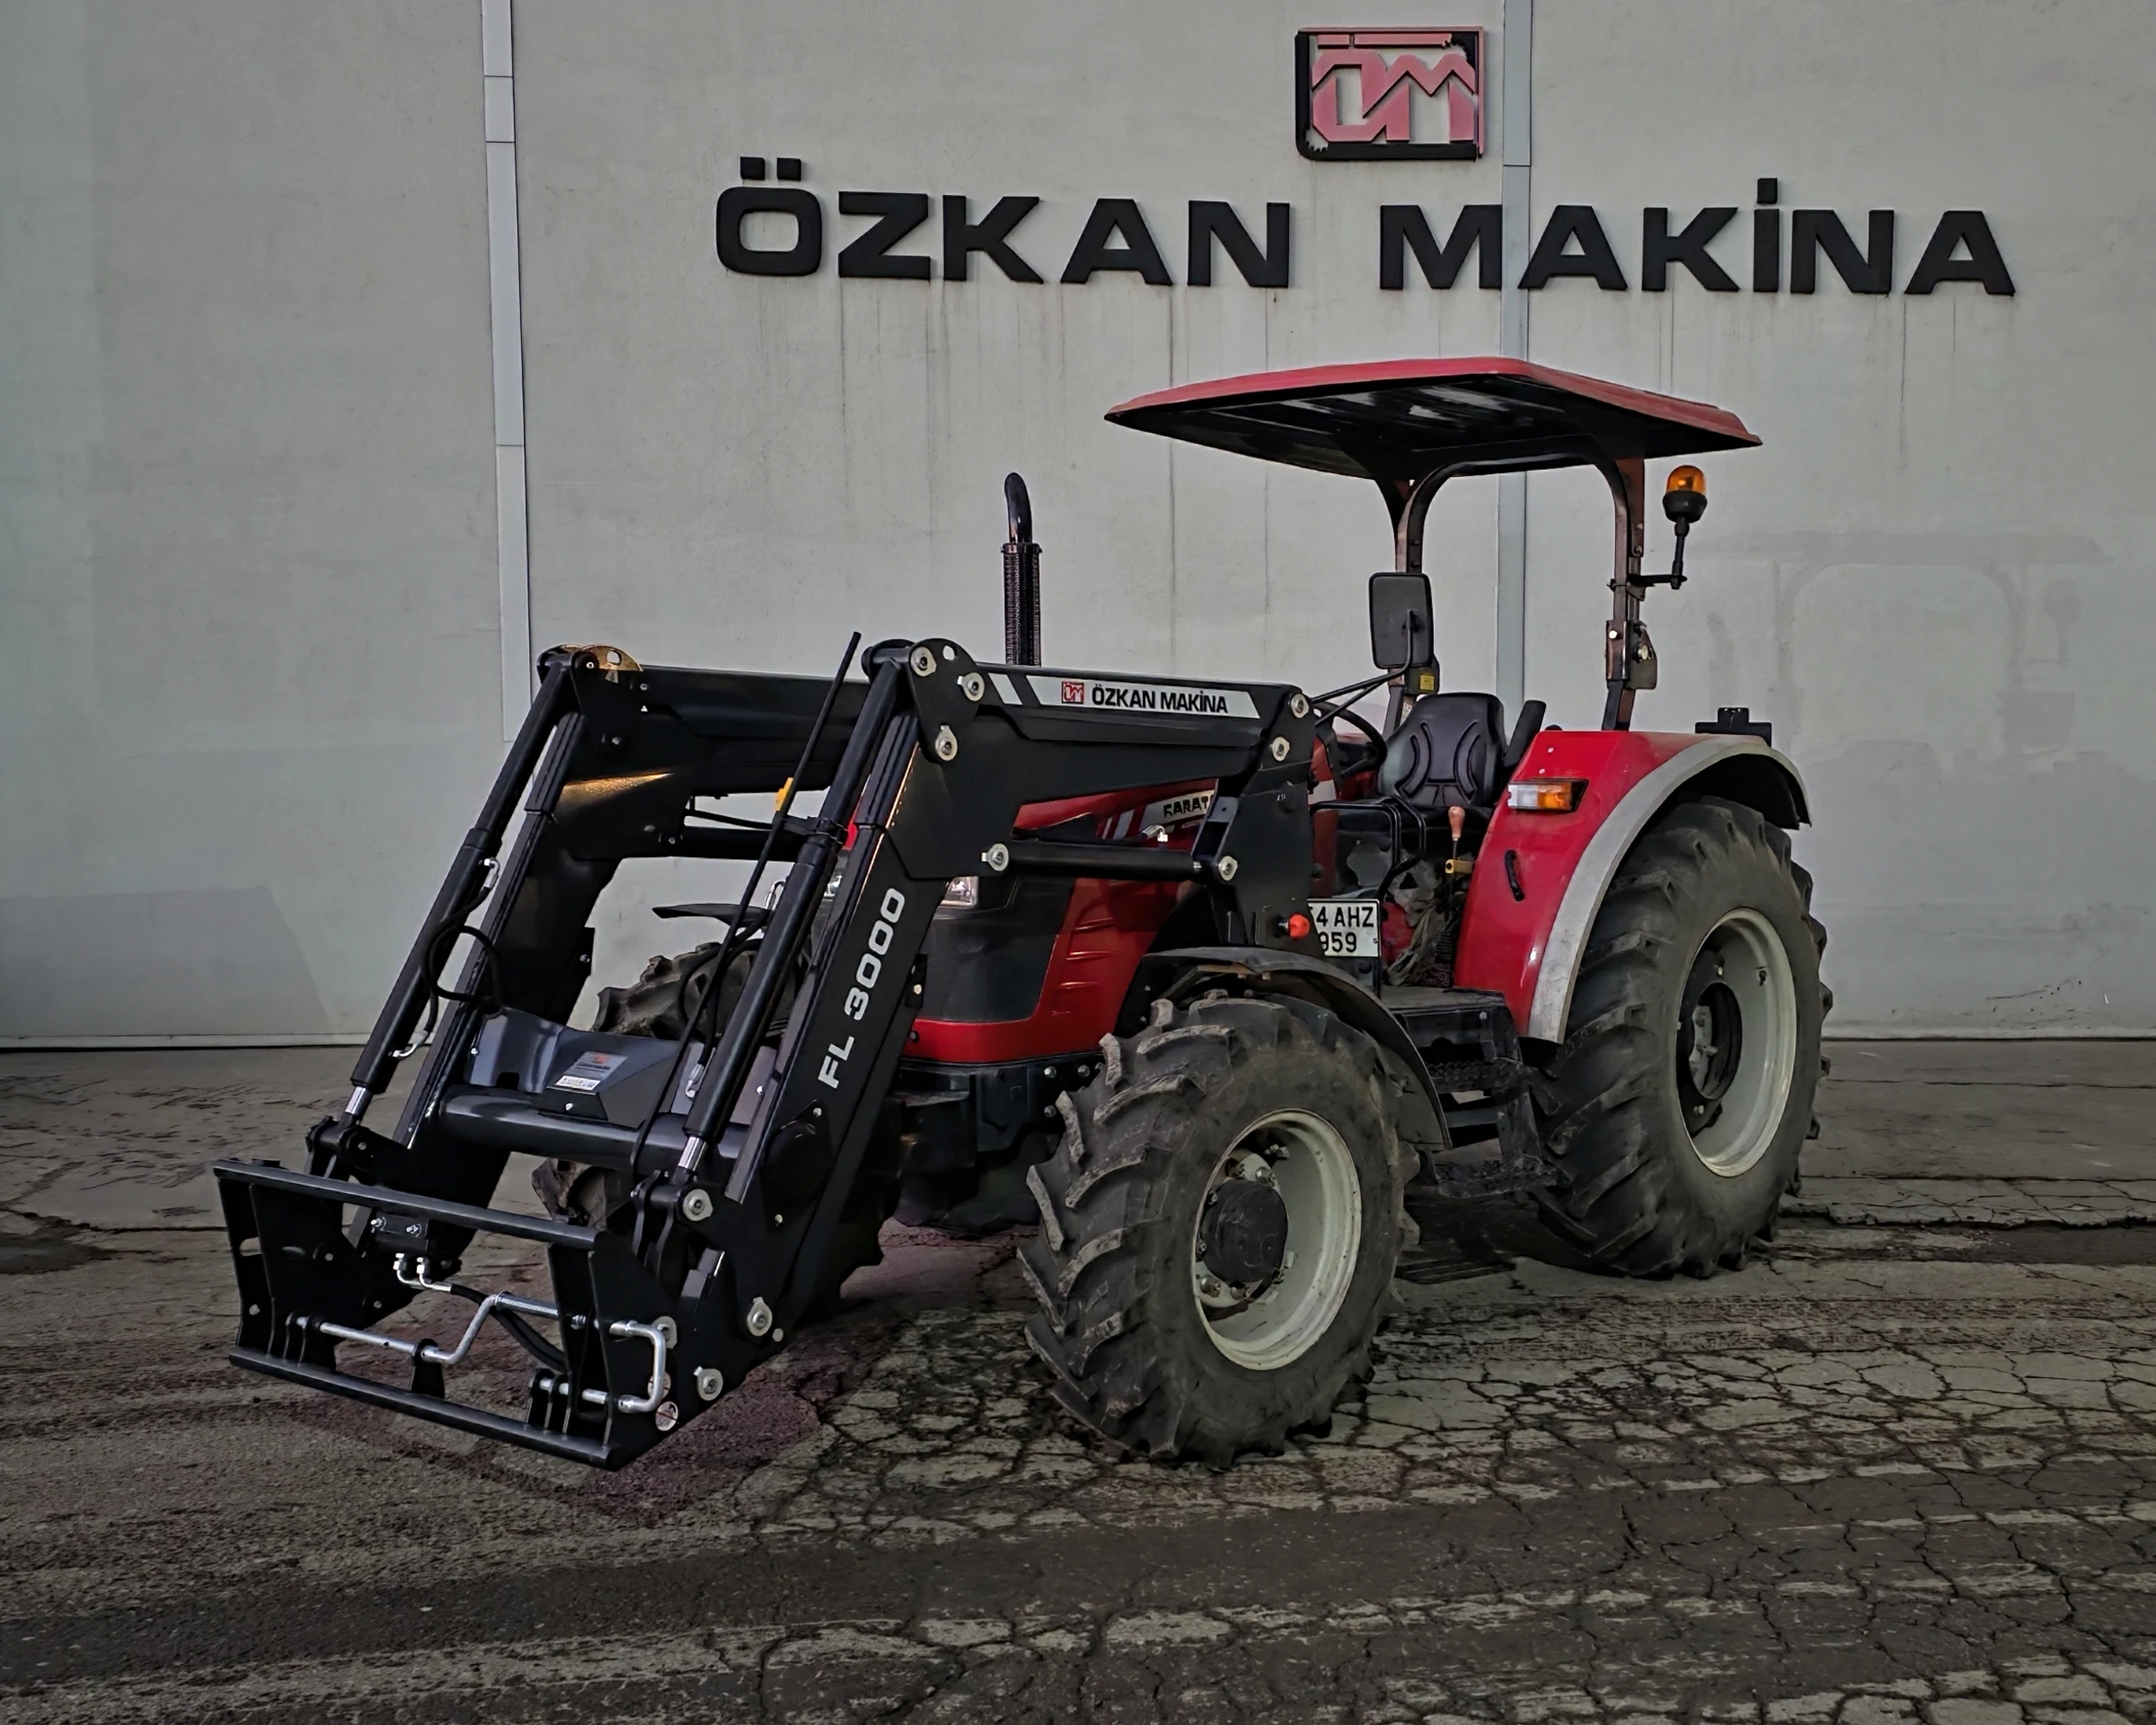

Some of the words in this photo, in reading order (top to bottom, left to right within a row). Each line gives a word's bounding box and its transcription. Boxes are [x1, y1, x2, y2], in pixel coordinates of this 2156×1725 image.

[716, 155, 1291, 289] ÖZKAN
[1379, 178, 2016, 296] MAKİNA
[1091, 684, 1156, 709] ÖZKAN
[1160, 690, 1229, 714] MAKİNA
[1163, 794, 1214, 818] KARAT
[1309, 906, 1328, 927] 4
[1334, 906, 1374, 928] AHZ
[817, 1035, 854, 1089] FL
[844, 888, 906, 1021] 3000
